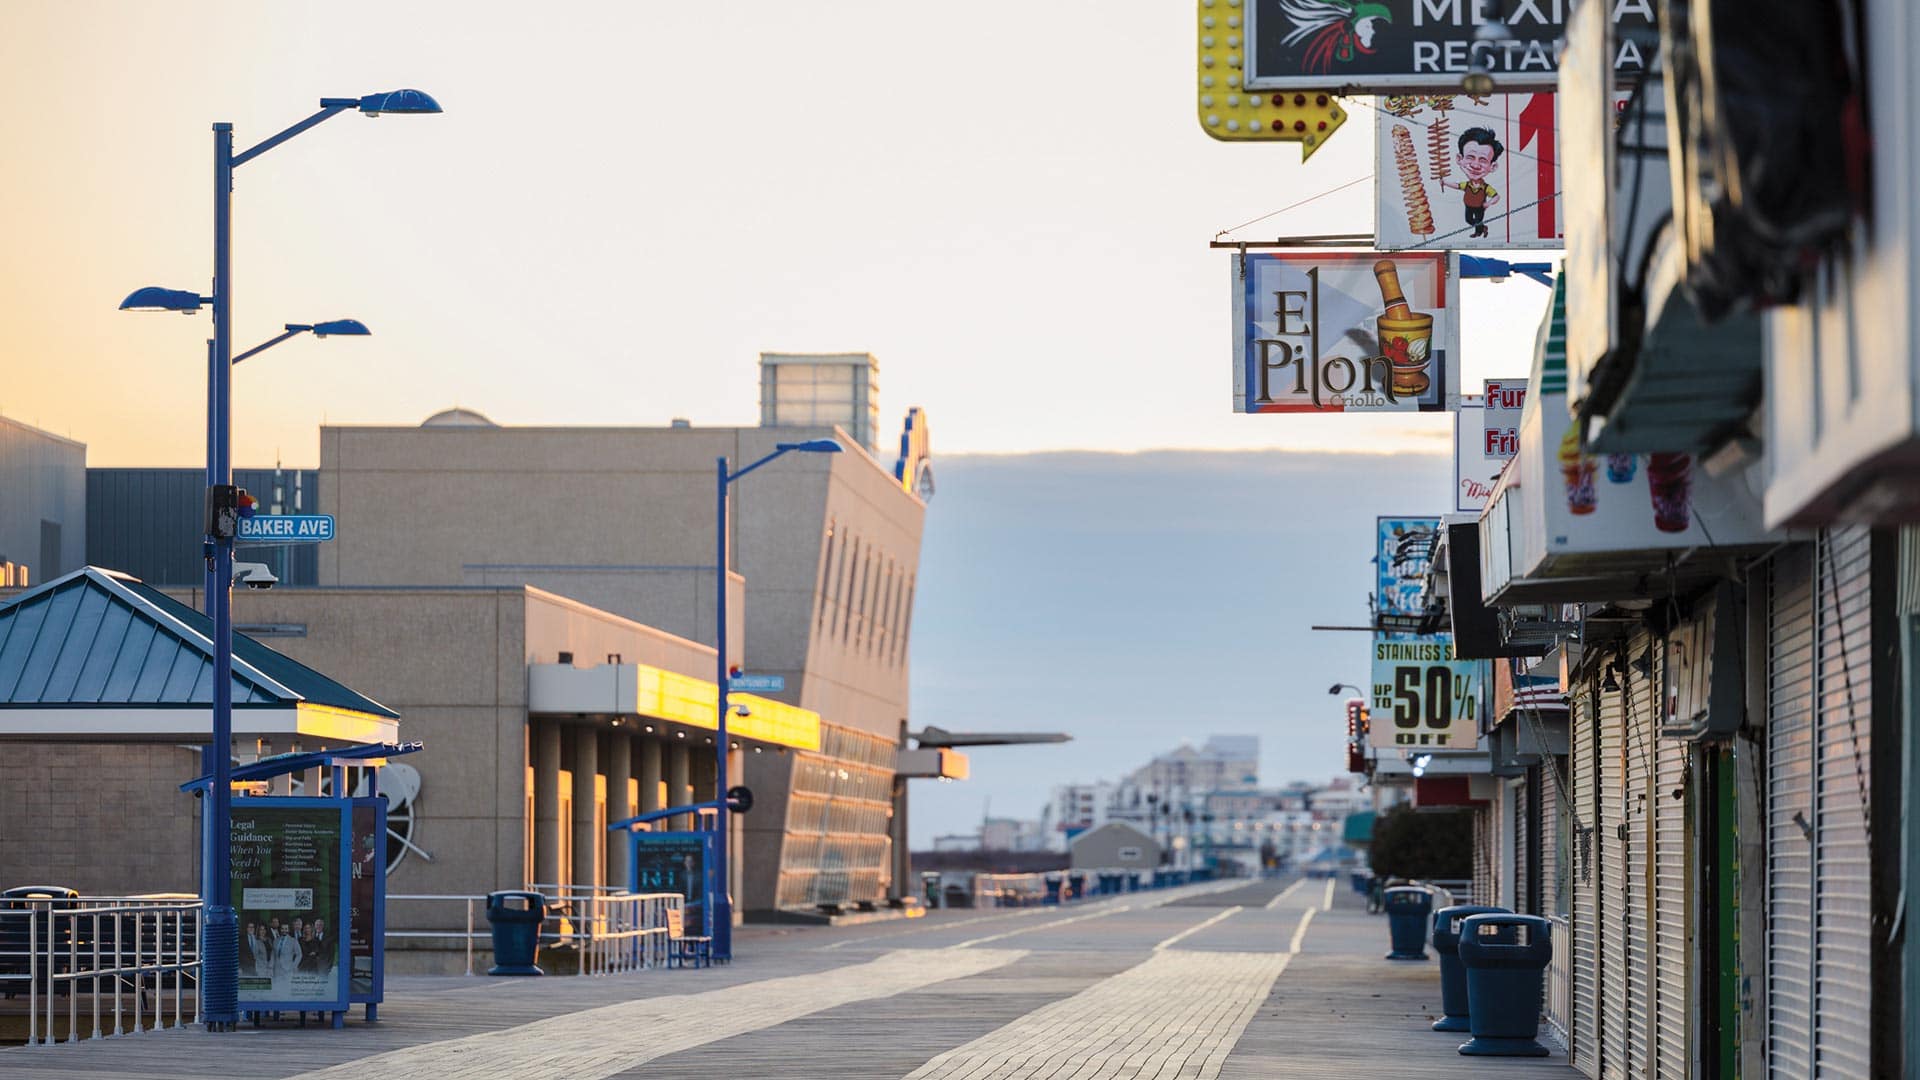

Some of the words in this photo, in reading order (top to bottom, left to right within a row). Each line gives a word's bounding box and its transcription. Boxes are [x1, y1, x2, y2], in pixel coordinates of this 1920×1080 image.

[1412, 0, 1655, 26] MEXIA
[1413, 39, 1644, 72] RESTAA
[1254, 322, 1399, 409] Pilon
[1329, 393, 1385, 407] Criollo
[242, 520, 294, 535] BAKER
[298, 519, 329, 535] AVE
[1377, 643, 1440, 661] STAINLESS
[1374, 684, 1392, 695] UP
[1374, 697, 1392, 708] TO
[1395, 666, 1475, 729] 50%
[1395, 733, 1452, 745] OFF
[230, 819, 255, 831] Legal
[230, 832, 273, 842] Guidance
[230, 844, 254, 855] When
[255, 844, 272, 855] You
[230, 857, 252, 867] Need
[253, 857, 261, 868] It
[230, 870, 251, 880] Most
